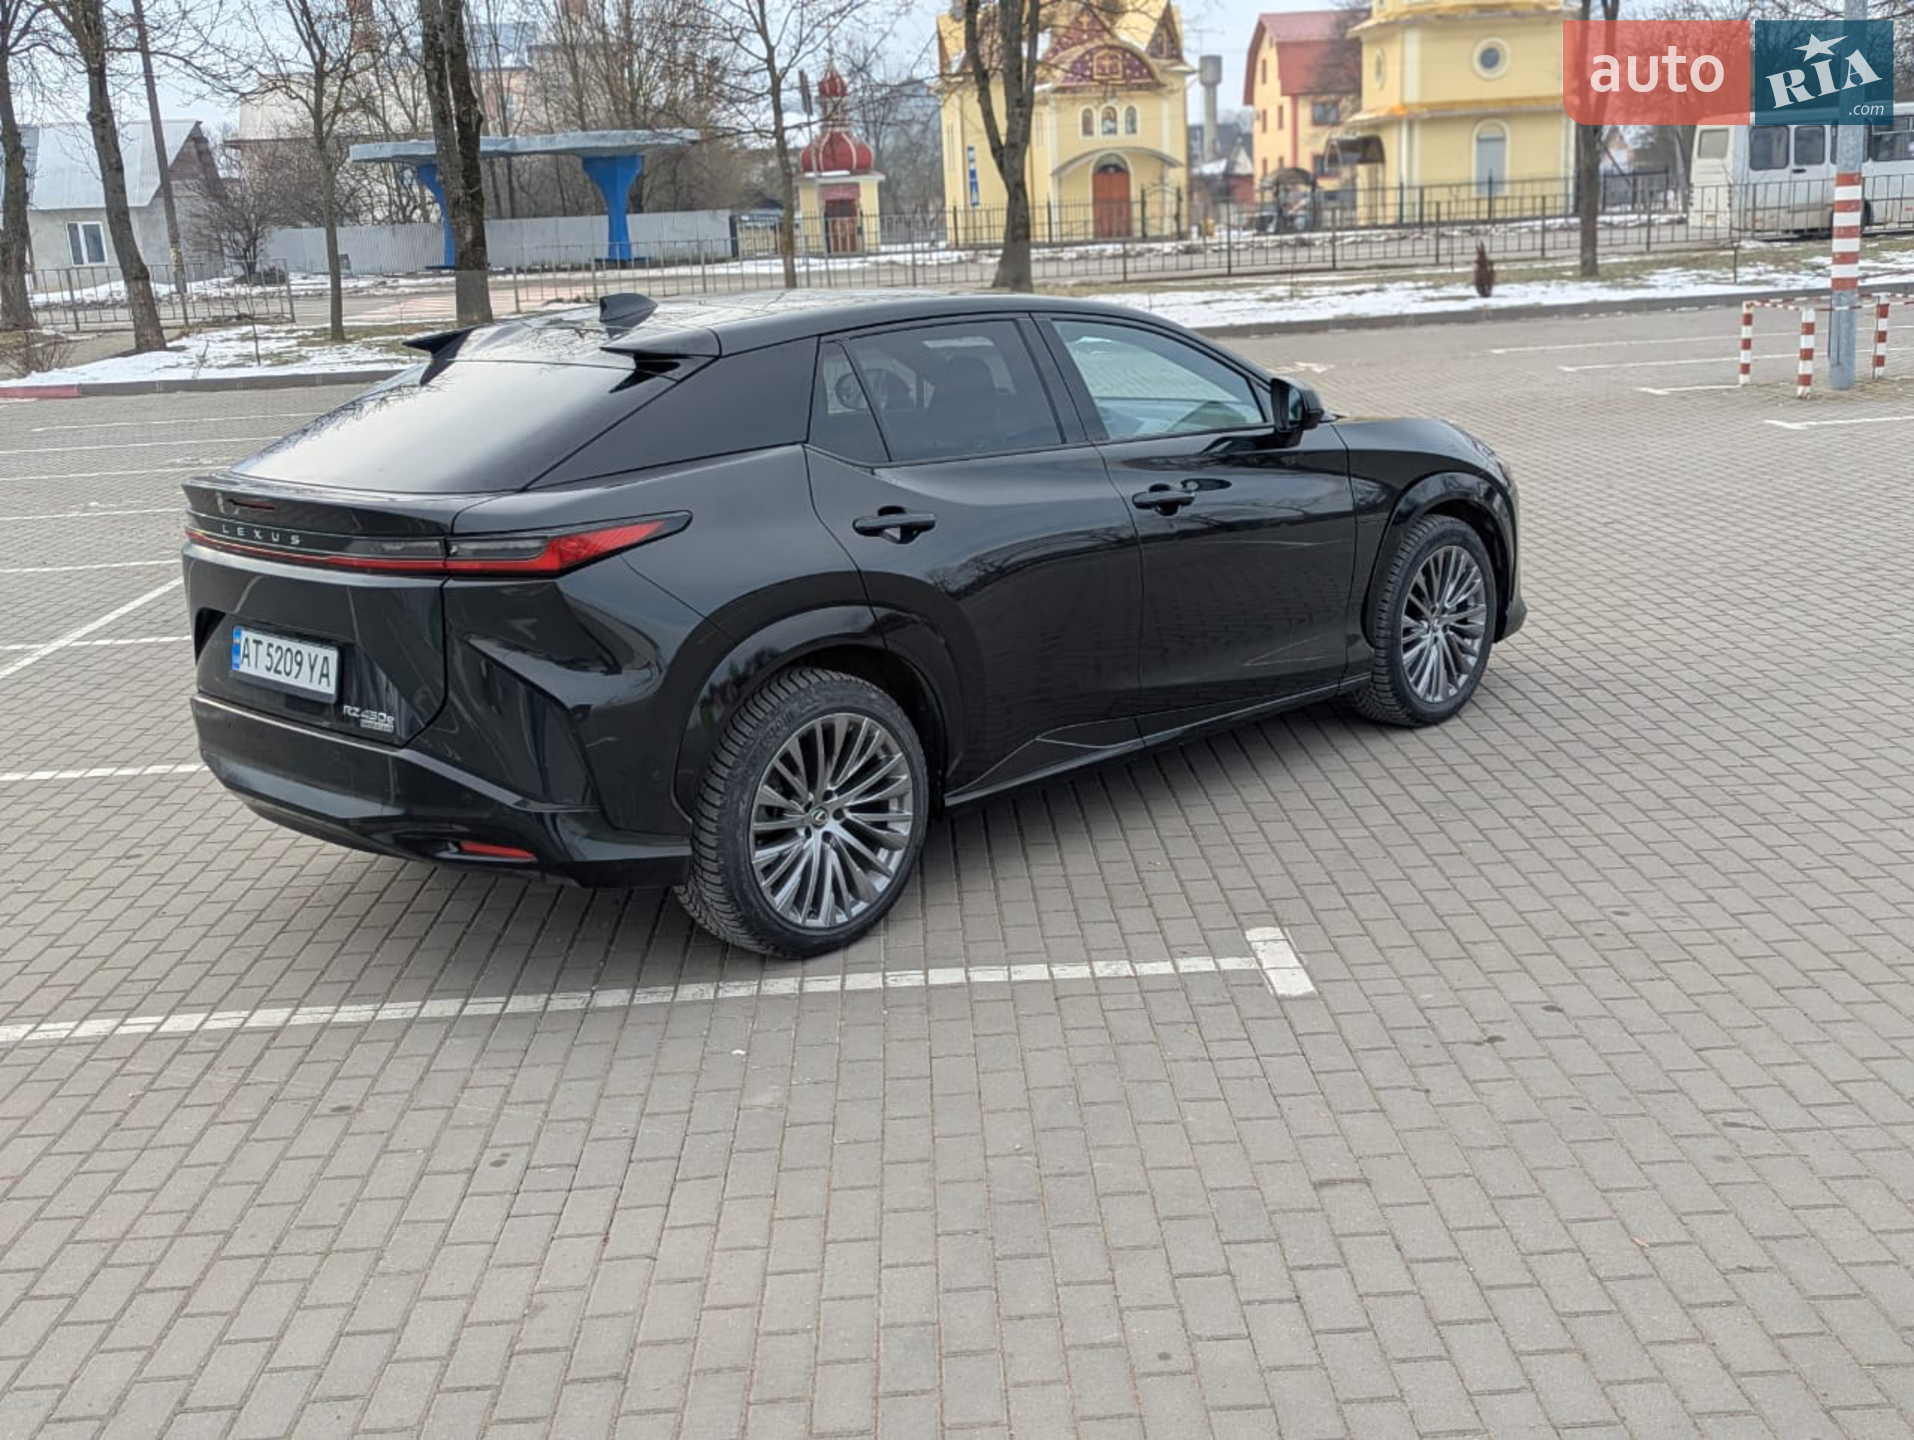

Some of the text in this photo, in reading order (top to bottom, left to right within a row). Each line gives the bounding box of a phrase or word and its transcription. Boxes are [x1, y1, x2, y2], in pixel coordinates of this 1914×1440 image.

[222, 524, 300, 545] LEXUS
[241, 637, 331, 687] AT 5209 YA
